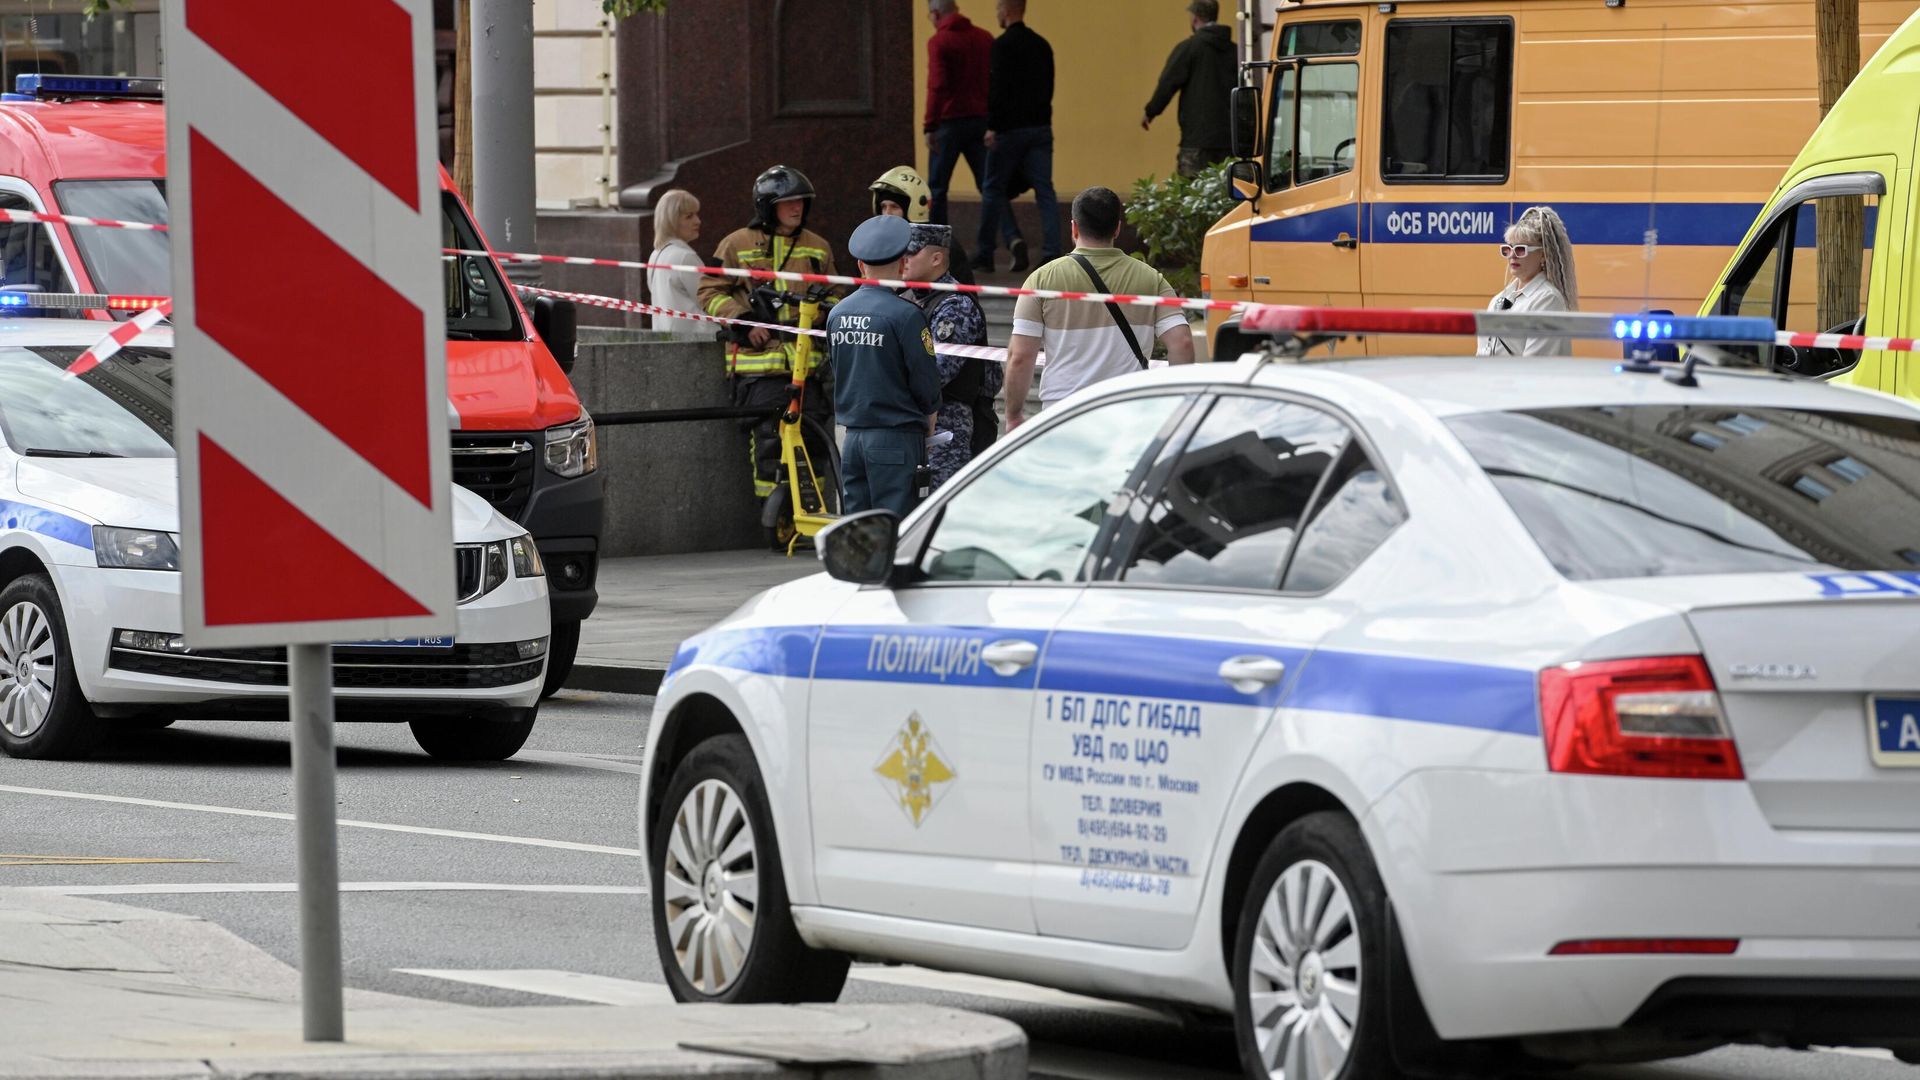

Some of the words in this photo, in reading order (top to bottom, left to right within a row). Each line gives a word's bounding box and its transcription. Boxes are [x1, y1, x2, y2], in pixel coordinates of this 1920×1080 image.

[1386, 211, 1423, 235] ФСБ
[1427, 211, 1494, 235] РОССИИ
[840, 315, 871, 330] МЧС
[830, 331, 885, 347] РОССИИ
[424, 635, 442, 645] RUS
[867, 634, 983, 682] ПОЛИЦИЯ
[1046, 694, 1053, 720] 1
[1061, 696, 1085, 722] БП
[1091, 698, 1131, 729] ДПС
[1137, 702, 1201, 737] ГИБДД
[1072, 733, 1104, 763] УВД
[1110, 742, 1128, 760] по
[1135, 738, 1169, 766] ЦАО
[1059, 764, 1084, 785] МВД
[1087, 767, 1125, 787] России
[1128, 775, 1142, 788] по
[1158, 774, 1200, 794] Москве
[1081, 795, 1105, 812] ТЕЛ.
[1108, 797, 1162, 818] ДОВЕРИЯ
[1088, 846, 1150, 868] ДЕЖУРНОЙ
[1153, 854, 1190, 875] ЧАСТИ
